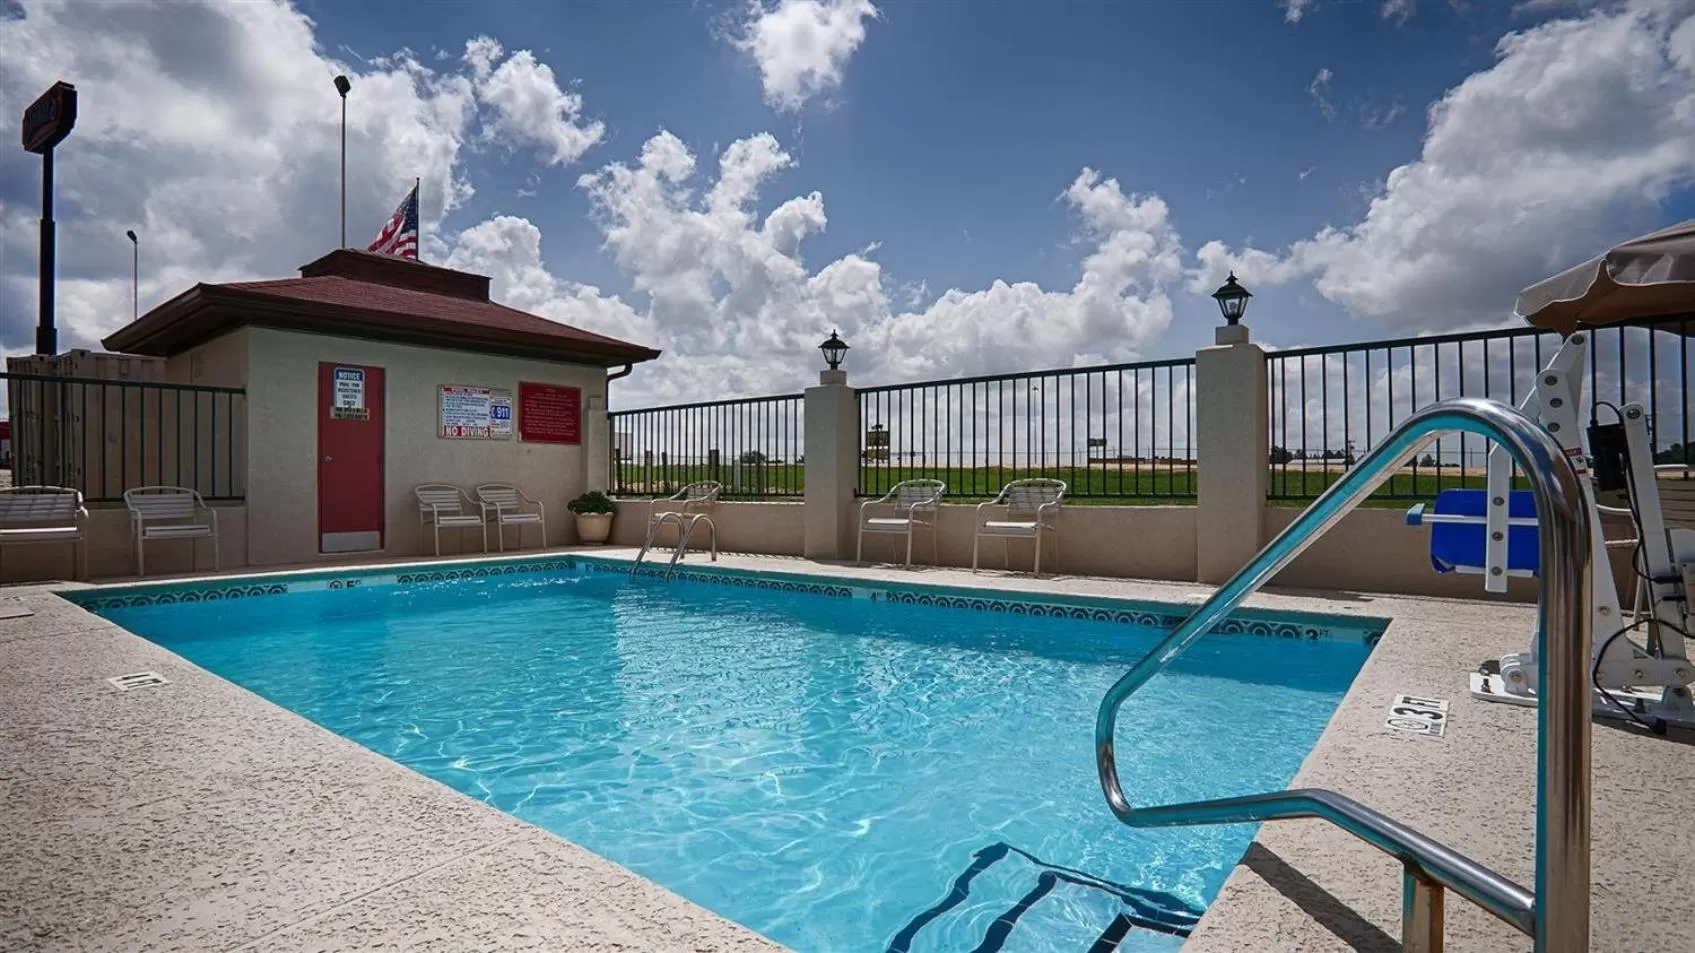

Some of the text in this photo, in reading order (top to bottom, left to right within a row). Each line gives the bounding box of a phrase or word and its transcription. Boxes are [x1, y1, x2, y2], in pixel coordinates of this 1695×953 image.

[338, 371, 361, 381] NOTICE
[496, 407, 509, 418] 911
[445, 426, 459, 436] NO
[461, 426, 489, 437] DIVING
[1393, 707, 1443, 720] 3
